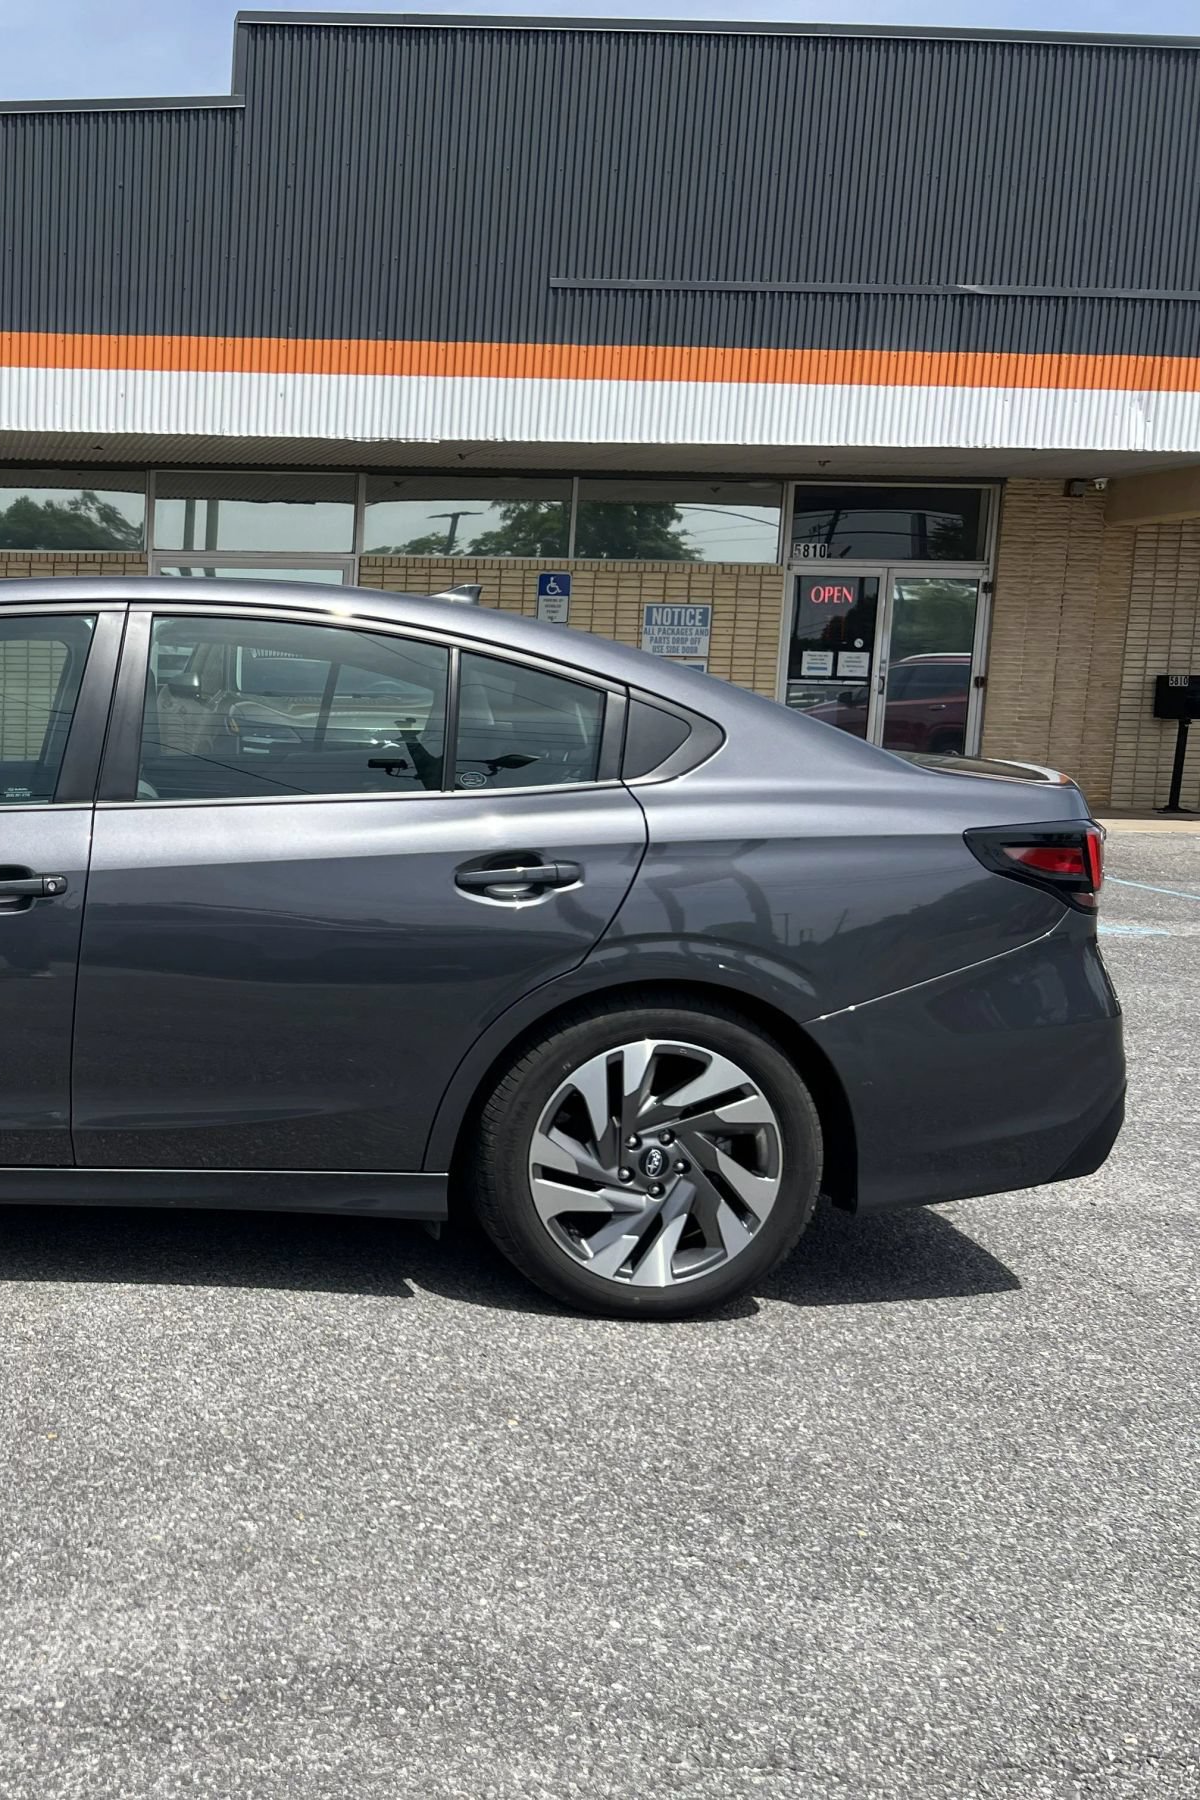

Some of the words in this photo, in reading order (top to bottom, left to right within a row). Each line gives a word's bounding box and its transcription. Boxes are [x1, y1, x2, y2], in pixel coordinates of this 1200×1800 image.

[794, 544, 826, 558] 5810
[810, 586, 854, 604] OPEN
[652, 608, 703, 626] NOTICE
[644, 627, 656, 636] ALL
[657, 627, 693, 637] PACKAGES
[694, 628, 709, 637] AND
[649, 636, 671, 645] PARTS
[671, 637, 689, 645] DROP
[689, 637, 702, 646] OFF
[652, 645, 665, 653] USE
[665, 646, 681, 654] SIDE
[1170, 676, 1189, 686] 5810
